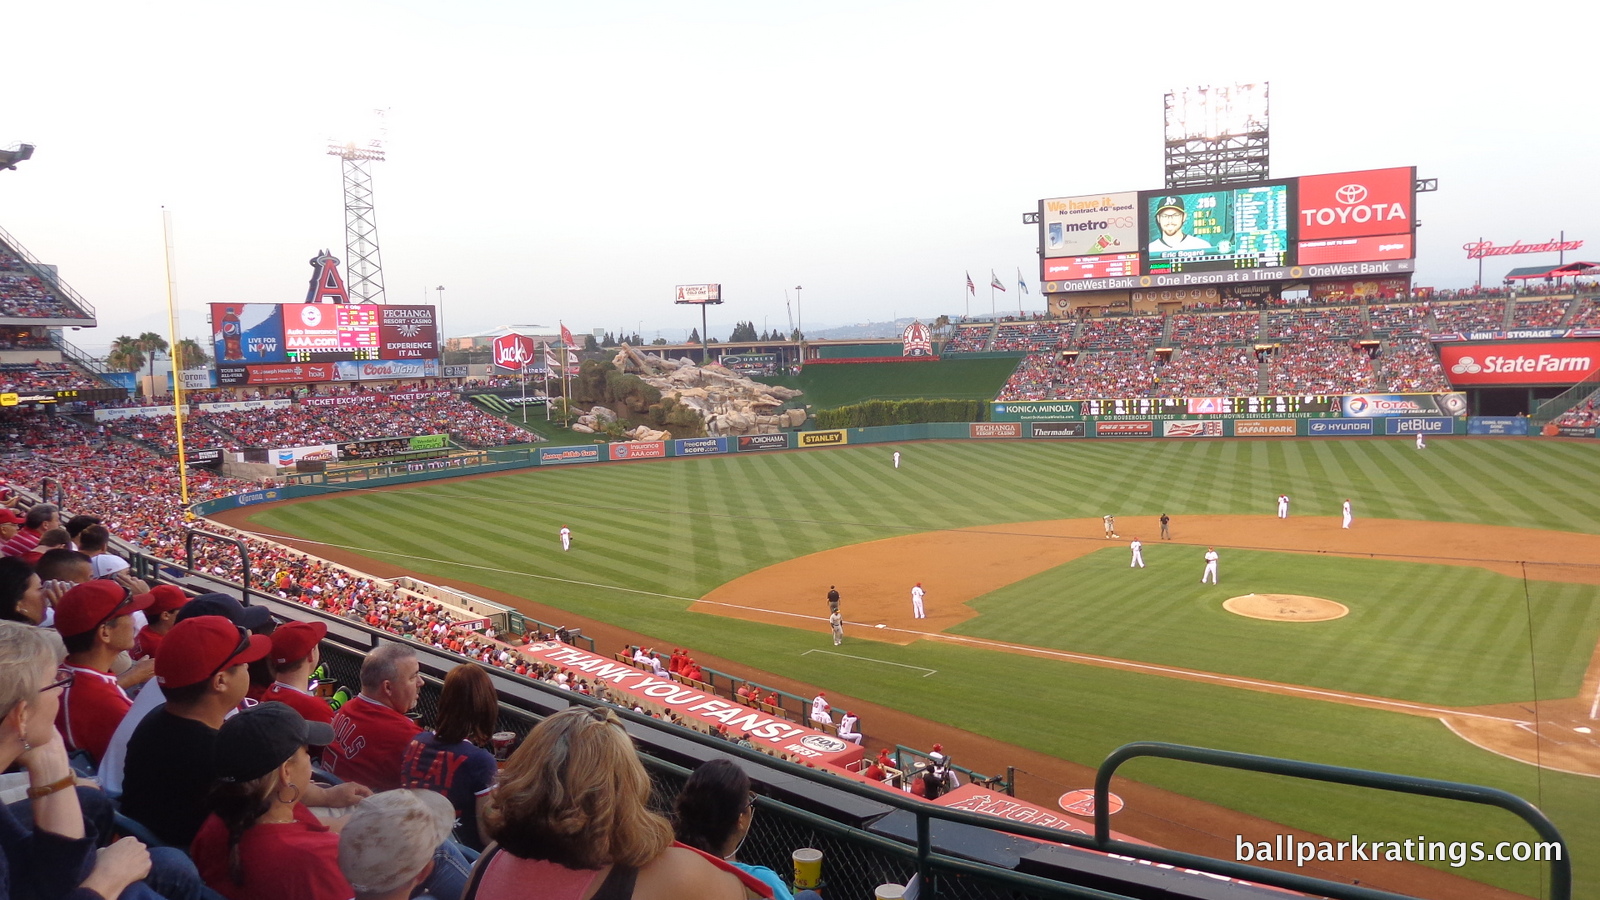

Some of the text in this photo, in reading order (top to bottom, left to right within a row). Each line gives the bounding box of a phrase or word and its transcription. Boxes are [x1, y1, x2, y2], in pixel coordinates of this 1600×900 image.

[1047, 197, 1115, 212] We have it.
[1069, 207, 1098, 215] contract.
[1112, 204, 1134, 212] speed.
[1301, 202, 1407, 227] TOYOTA
[1066, 216, 1134, 232] metroPCS
[1178, 250, 1205, 259] Sogard
[1463, 238, 1584, 259] Budweiser
[1308, 262, 1389, 277] OneWest Bank
[1157, 270, 1283, 286] One Person at a Time
[1063, 279, 1133, 291] OneWest Bank
[382, 309, 432, 318] PECHANGA
[1470, 332, 1492, 340] MINI
[287, 337, 338, 348] AAA.com
[386, 342, 433, 350] EXPERIENCE
[405, 349, 422, 357] ALL
[497, 337, 527, 364] Jack
[363, 363, 393, 376] Coors
[392, 365, 420, 375] LIGHT
[1483, 354, 1591, 374] State Farm
[177, 371, 207, 383] Corona
[306, 398, 335, 406] TICKET
[389, 393, 415, 401] TICKET
[1006, 404, 1075, 413] KONICA MINOLTA
[1372, 400, 1419, 409] TOTAL
[1237, 426, 1268, 434] SAFARI
[1396, 418, 1442, 433] jetBlue
[1033, 428, 1074, 436] Thermador
[683, 439, 717, 447] freecredit
[805, 434, 839, 443] STANLEY
[238, 493, 264, 505] Corona
[544, 646, 805, 744] THANK YOU FANS!
[811, 736, 837, 748] FOX
[784, 743, 823, 758] WEST
[403, 739, 468, 788] PLAY
